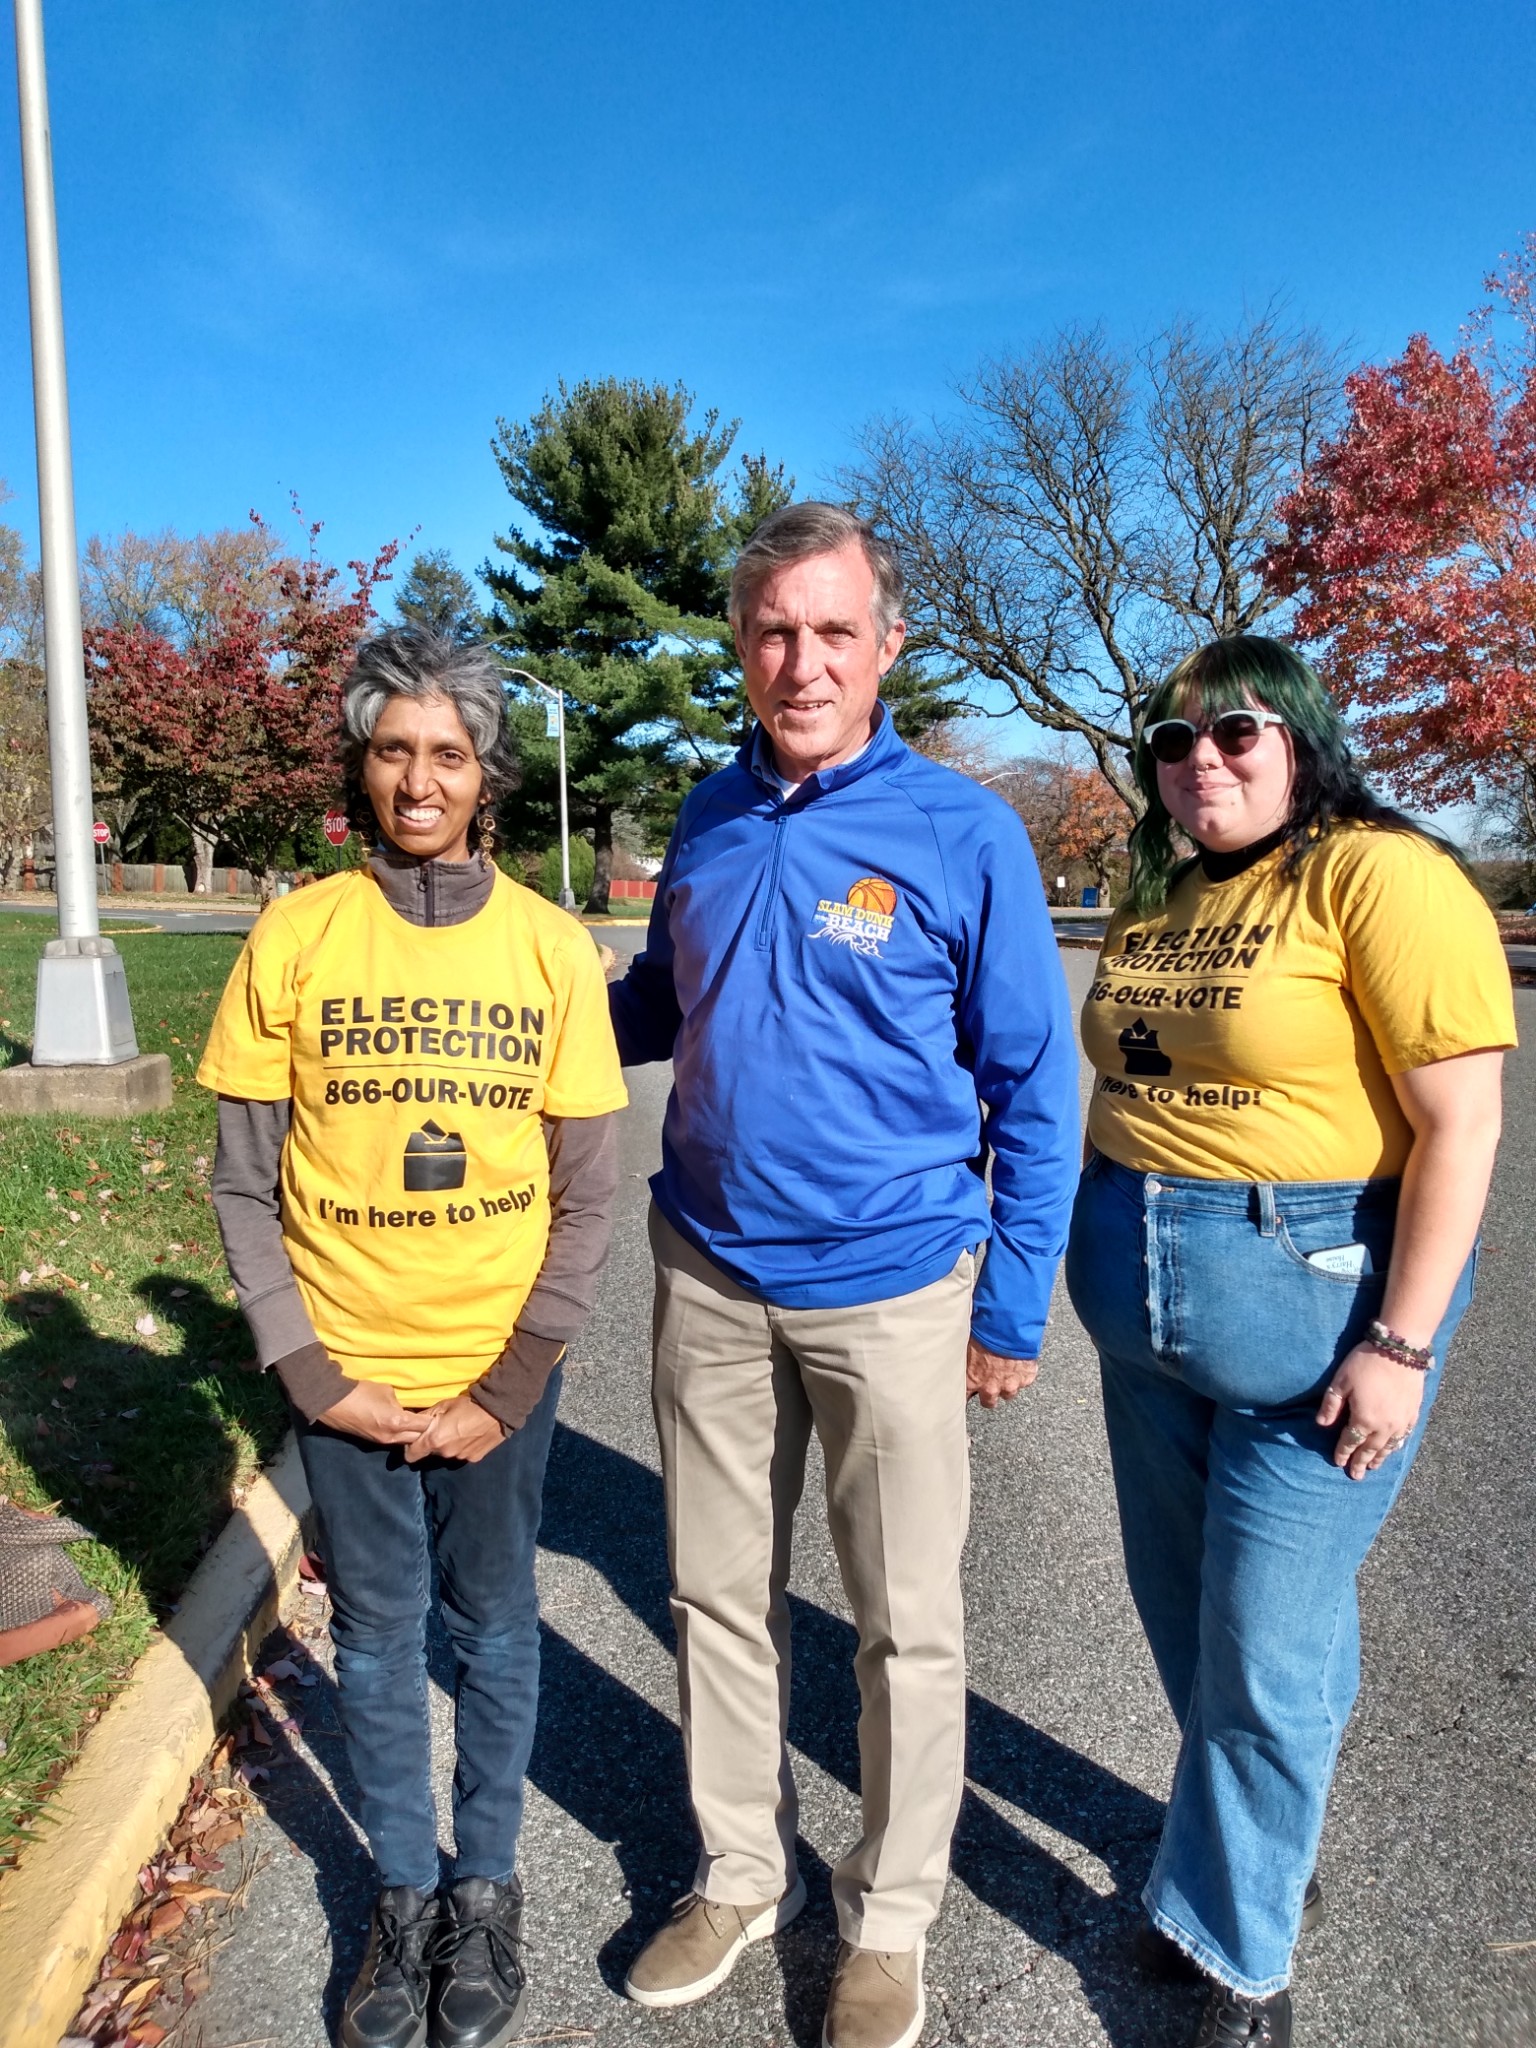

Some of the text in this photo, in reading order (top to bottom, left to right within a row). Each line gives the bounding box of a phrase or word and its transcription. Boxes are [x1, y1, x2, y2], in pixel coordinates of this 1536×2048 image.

[326, 817, 350, 833] STOP
[818, 900, 895, 929] SLAM DUNK
[826, 914, 891, 942] BEACH
[1124, 923, 1273, 953] ELECTION
[1109, 948, 1261, 972] PROTECTION
[321, 997, 543, 1035] ELECTION
[321, 1027, 541, 1066] PROTECTION
[324, 1077, 534, 1110] 866-OUR-VOTE
[1147, 1086, 1175, 1104] to
[1185, 1085, 1261, 1110] help!
[319, 1183, 536, 1228] I'm here to help!
